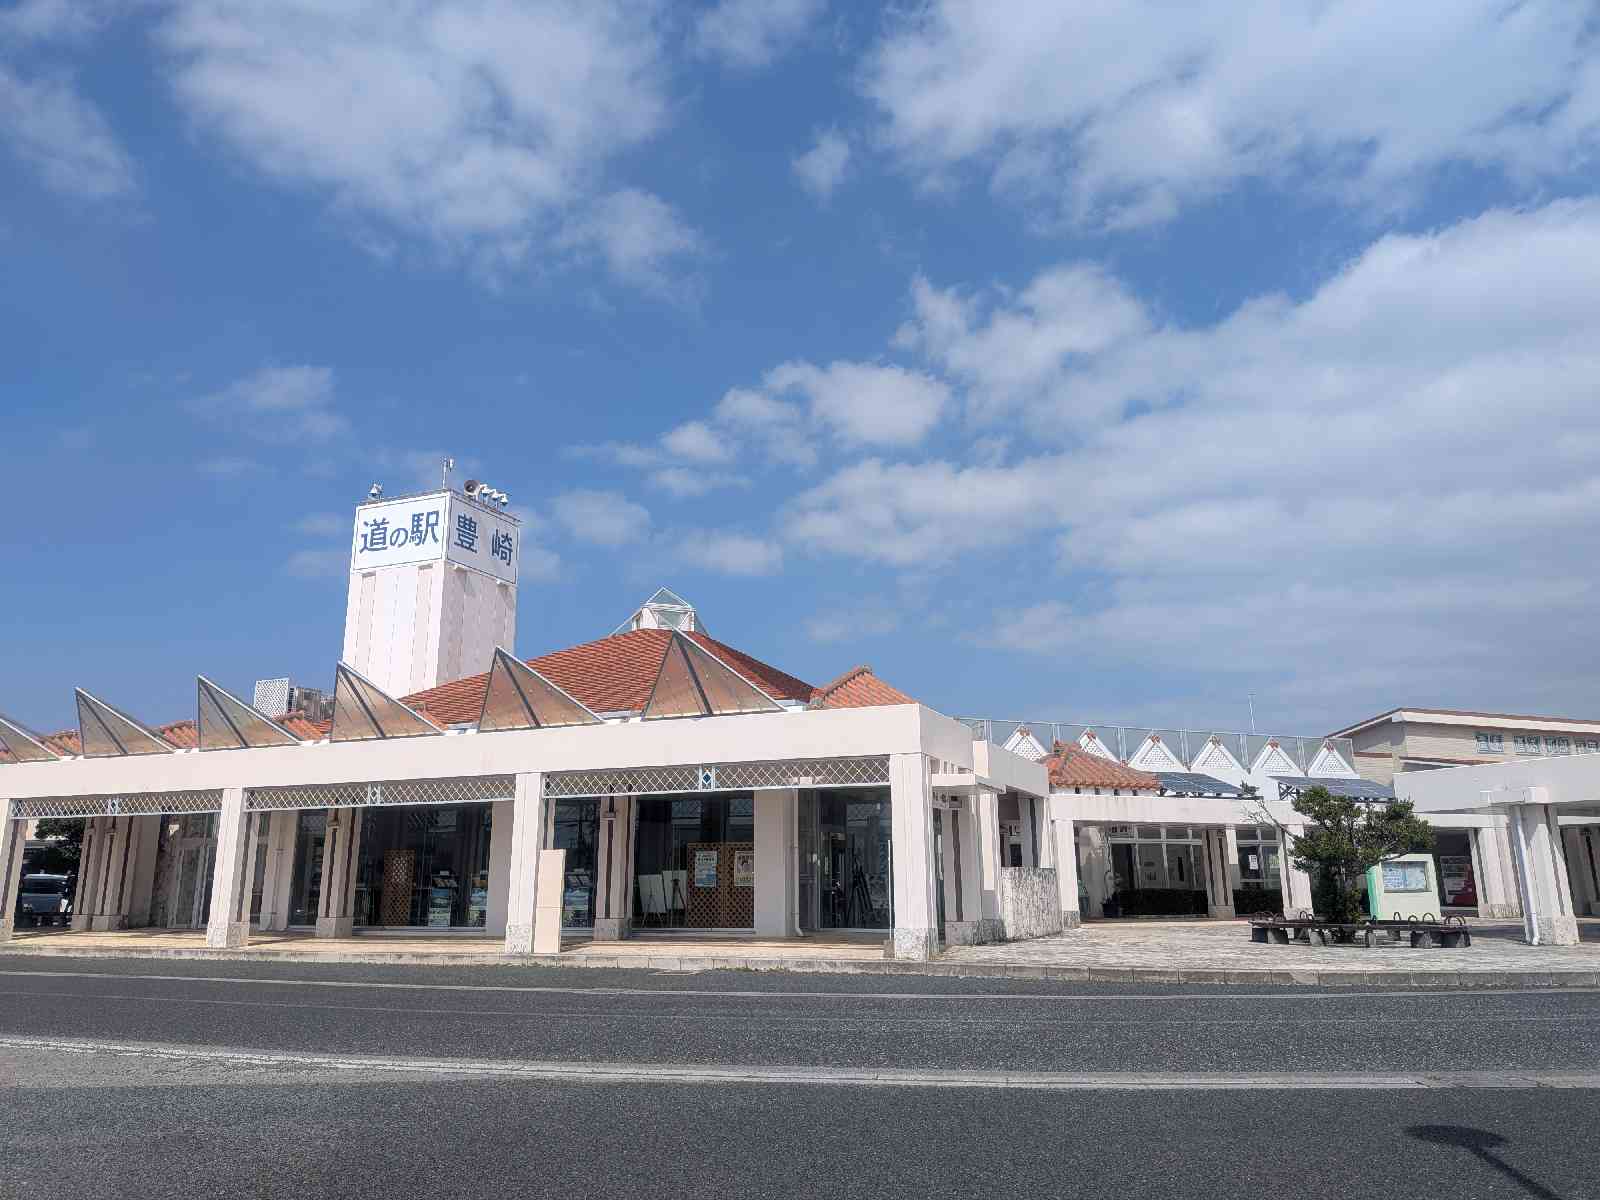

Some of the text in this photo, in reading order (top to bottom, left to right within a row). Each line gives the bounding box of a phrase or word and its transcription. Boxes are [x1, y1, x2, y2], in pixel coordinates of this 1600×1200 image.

[359, 510, 440, 554] 道の駅
[454, 512, 514, 566] 豊崎
